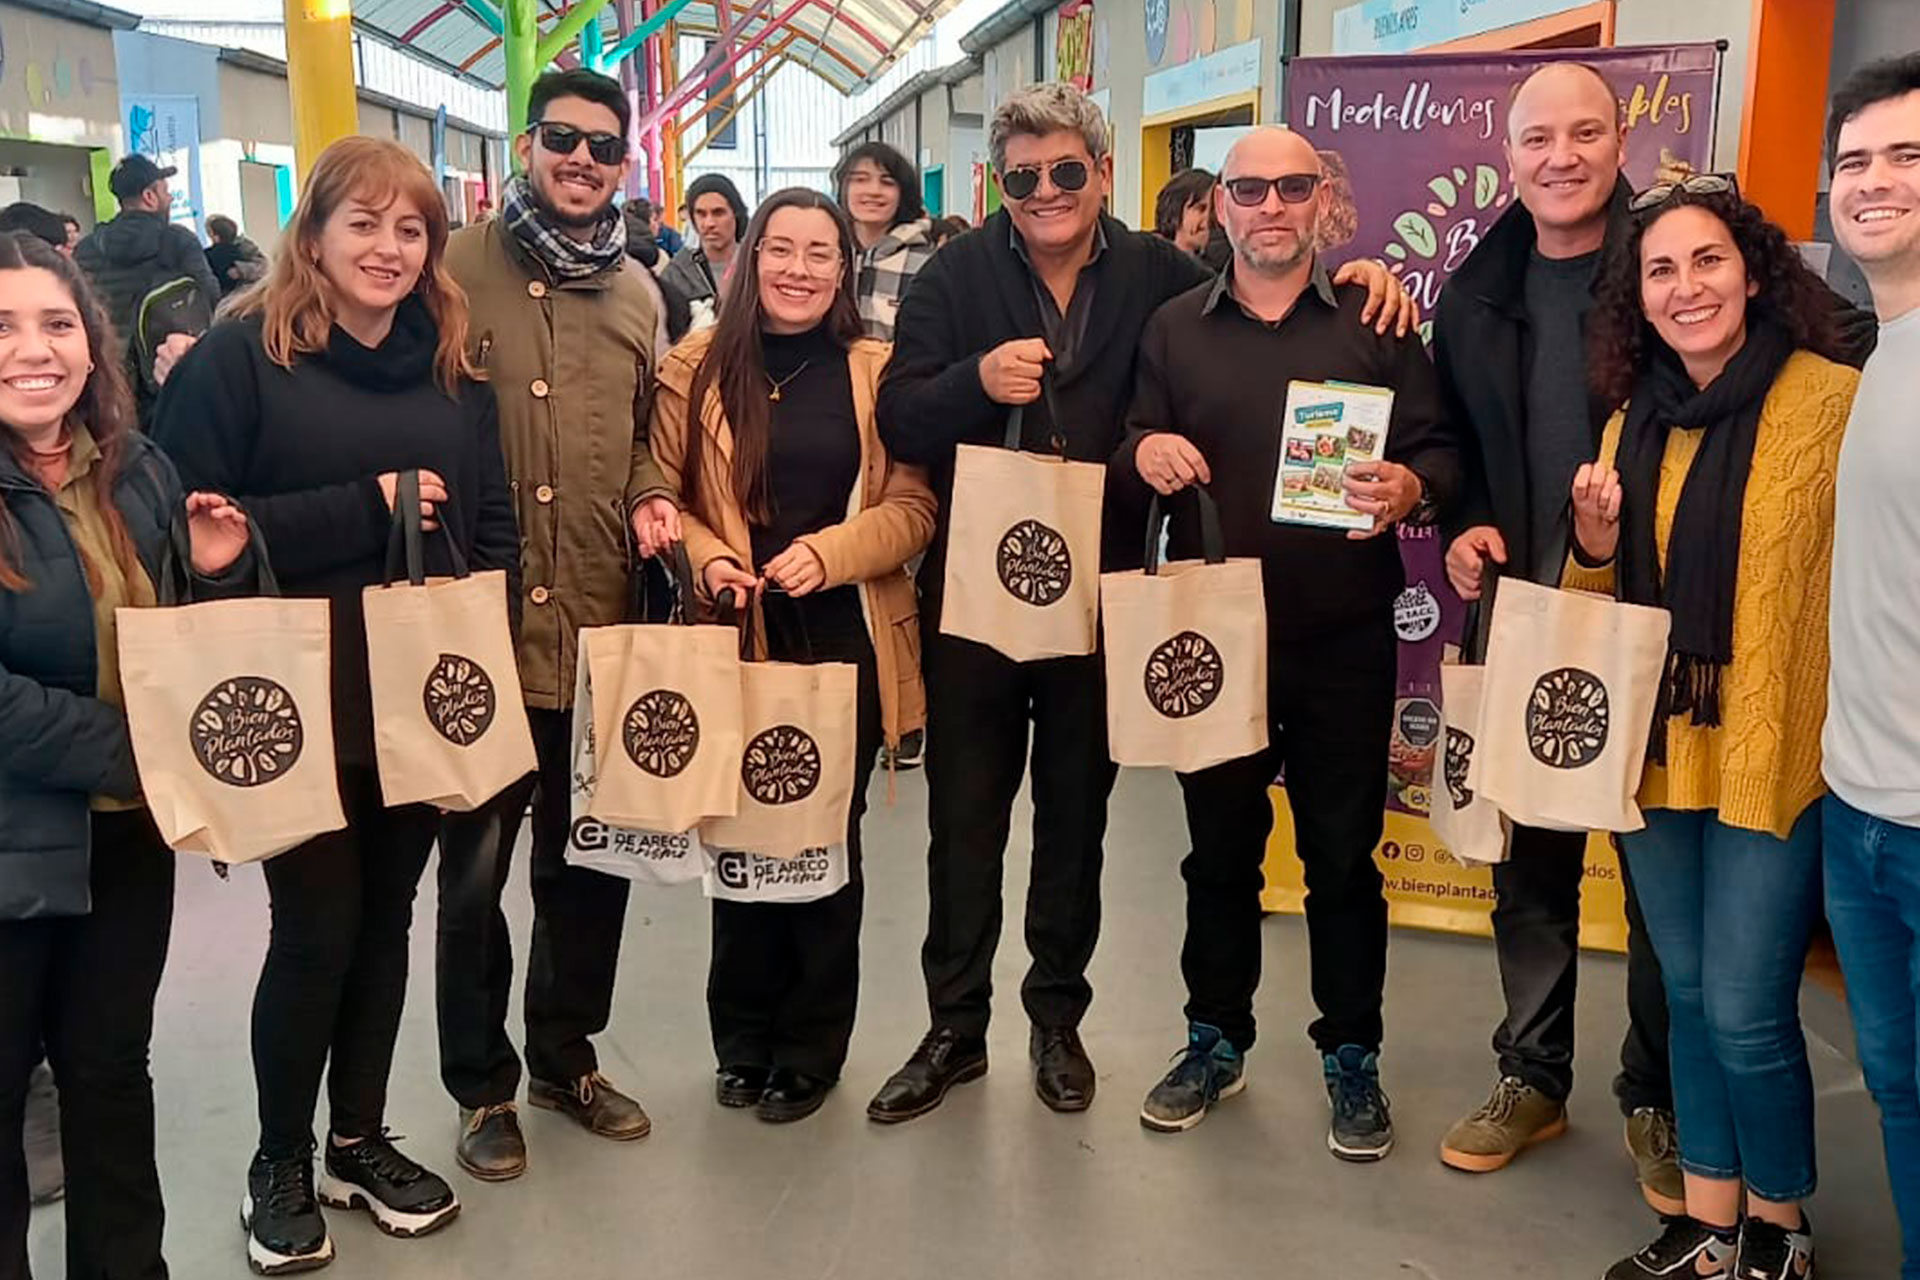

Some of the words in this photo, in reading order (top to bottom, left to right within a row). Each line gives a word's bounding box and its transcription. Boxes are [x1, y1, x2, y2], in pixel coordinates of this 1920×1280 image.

[1306, 81, 1495, 137] Medallones
[1554, 696, 1589, 717] Bien
[227, 708, 269, 735] Bien
[652, 713, 680, 734] Bien
[1531, 714, 1604, 737] Plantados
[204, 722, 294, 763] Plantados
[632, 729, 693, 754] Plantados
[769, 749, 800, 767] Bien
[752, 763, 814, 788] Plantados
[615, 833, 636, 845] DE
[640, 835, 689, 849] ARECO
[614, 843, 686, 861] Turismo
[754, 864, 774, 878] DE
[779, 859, 829, 874] ARECO
[755, 872, 827, 890] Turismo
